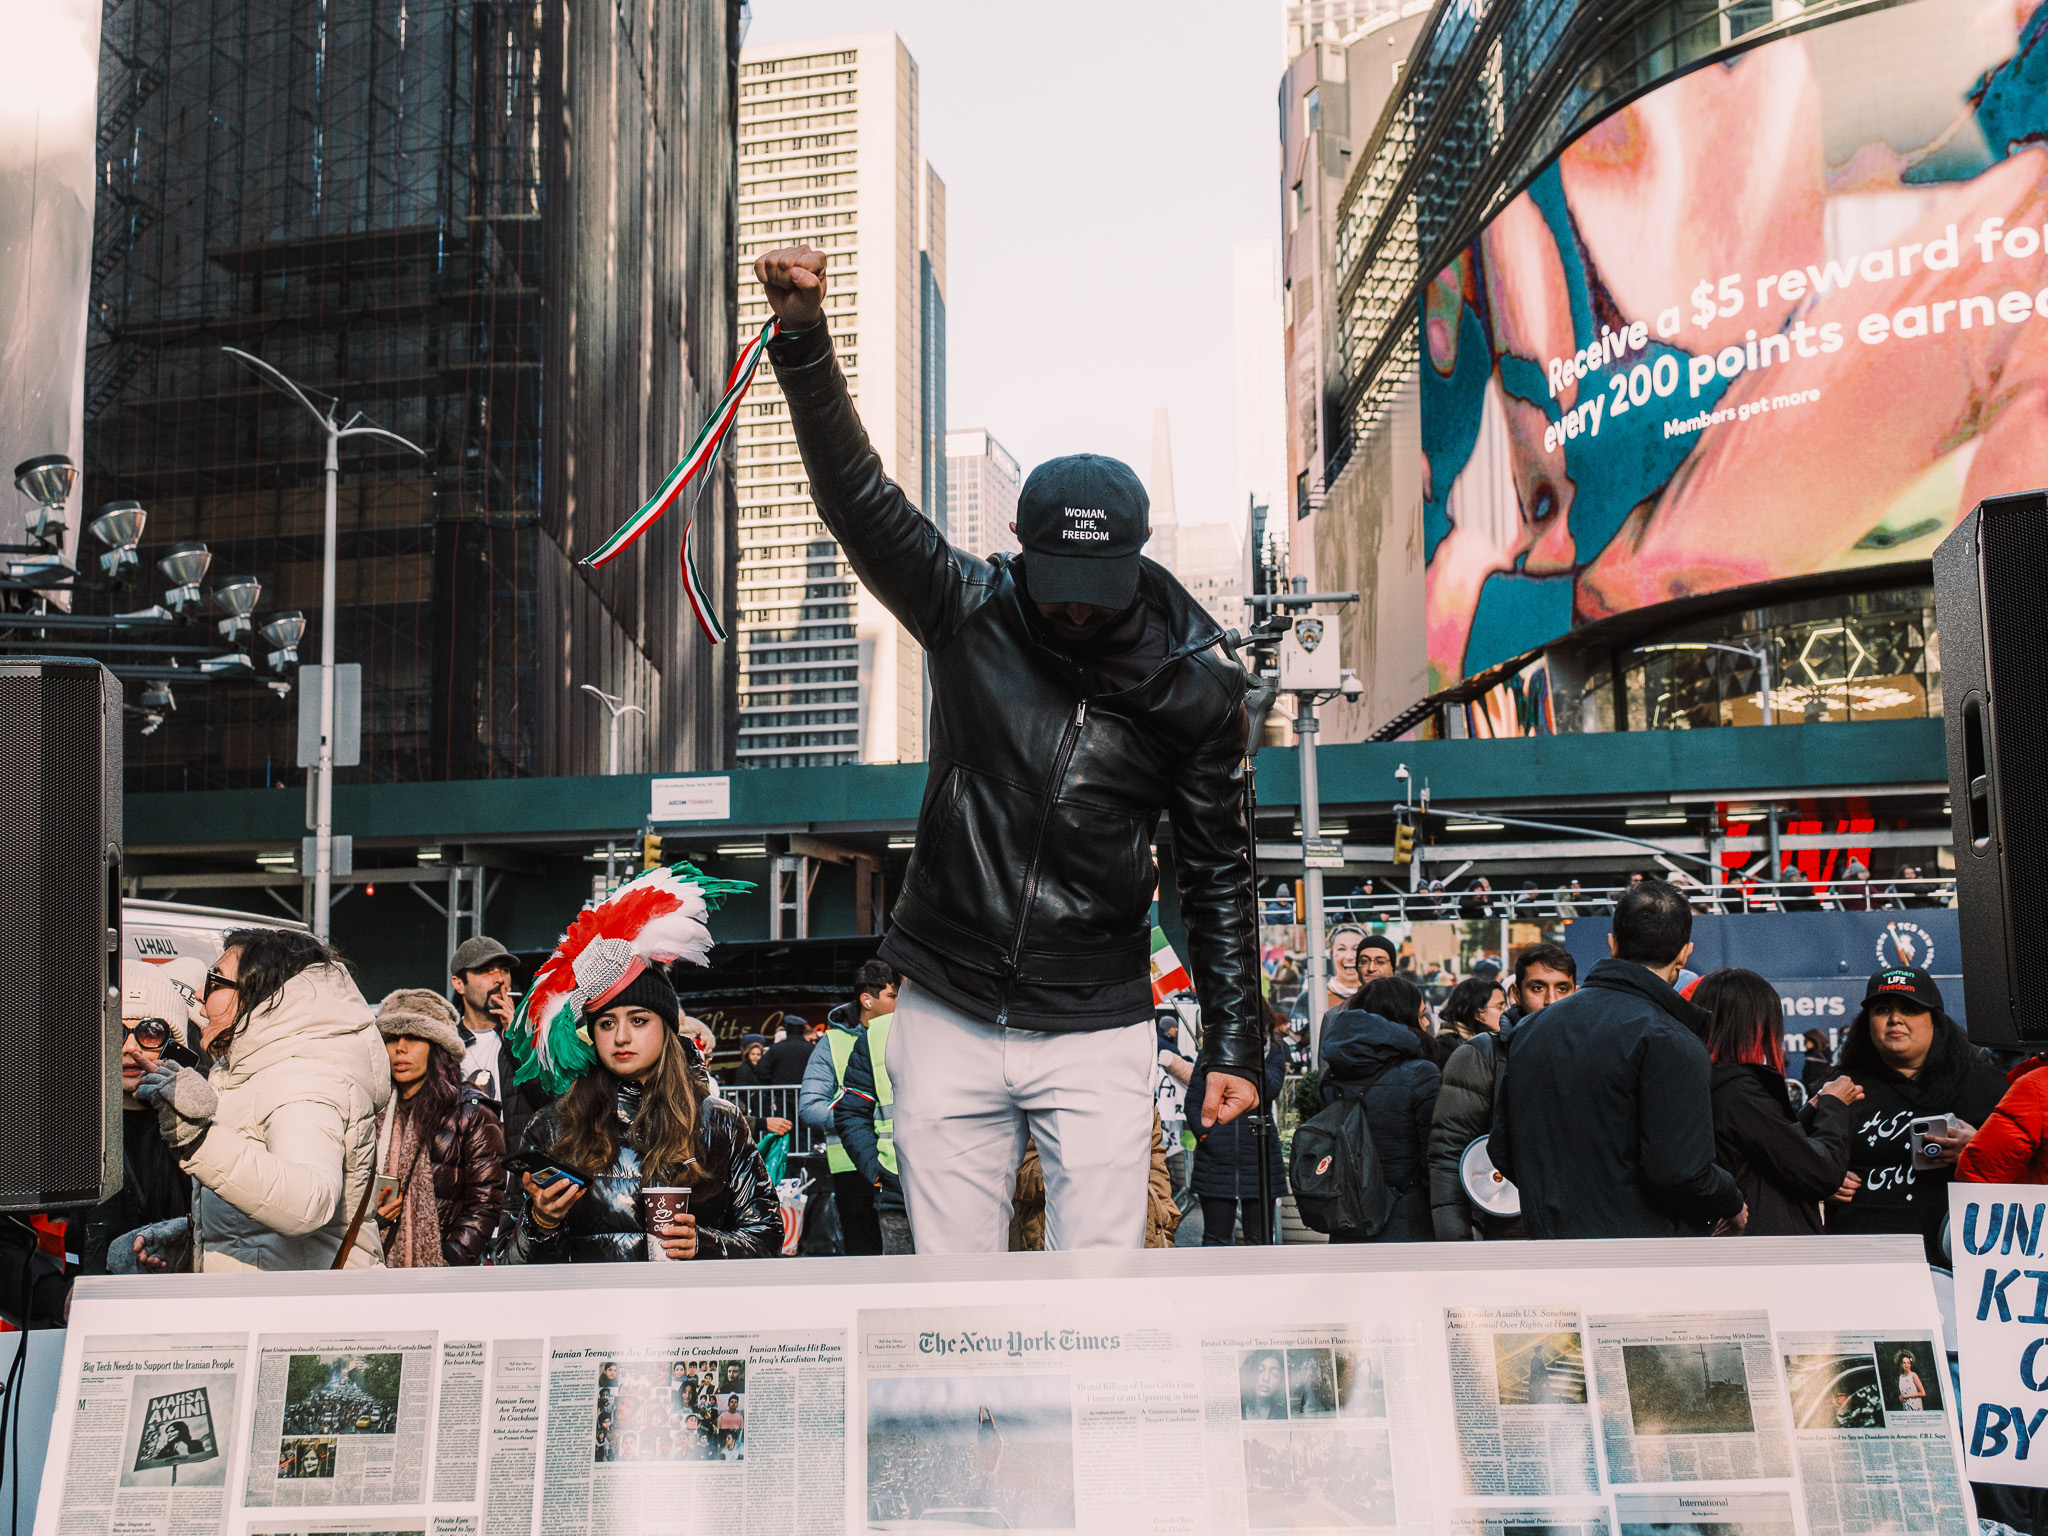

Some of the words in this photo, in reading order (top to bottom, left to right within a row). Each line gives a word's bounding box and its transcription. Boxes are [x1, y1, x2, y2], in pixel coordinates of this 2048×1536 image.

[1548, 319, 1649, 399] Receive
[1656, 305, 1681, 338] a
[1690, 273, 1745, 330] $5
[1756, 224, 1958, 308] reward
[1543, 394, 1606, 454] every
[1608, 353, 1679, 418] 200
[1688, 319, 1844, 399] points
[1663, 404, 1737, 440] Members
[1738, 396, 1768, 426] get
[1772, 387, 1821, 411] more
[1064, 506, 1107, 520] WOMAN,
[1075, 519, 1097, 531] LIFE,
[1062, 529, 1109, 541] FREEDOM
[134, 937, 179, 955] U-HAUL
[1882, 970, 1915, 978] woman
[1887, 975, 1907, 985] LIFE
[1878, 983, 1916, 993] Freedom
[1857, 1110, 1881, 1147] پلو
[1962, 1202, 2047, 1259] UN,
[1447, 1310, 1467, 1319] Iran's
[1468, 1310, 1494, 1318] Leader
[1496, 1309, 1522, 1318] Assails
[1523, 1309, 1539, 1318] U.S.
[1540, 1309, 1577, 1317] Sanctions
[1447, 1321, 1468, 1329] Amid
[1470, 1321, 1498, 1329] Turmoil
[1500, 1321, 1518, 1329] Over
[1519, 1320, 1543, 1330] Rights
[1544, 1320, 1553, 1328] at
[1554, 1320, 1577, 1328] Home
[749, 1345, 776, 1353] Iranian
[777, 1344, 806, 1352] Missiles
[807, 1343, 819, 1352] Hit
[820, 1343, 841, 1351] Bases
[919, 1331, 957, 1357] The
[959, 1331, 1002, 1355] New
[1006, 1329, 1056, 1357] York
[1059, 1328, 1121, 1351] Times
[1222, 1339, 1245, 1348] Killing
[1246, 1338, 1252, 1346] of
[1254, 1338, 1268, 1346] Two
[1270, 1338, 1296, 1348] Teenage
[1297, 1337, 1313, 1345] Girls
[1314, 1337, 1330, 1345] Fans
[1331, 1336, 1355, 1345] Flames
[551, 1349, 582, 1360] Iranian
[584, 1348, 625, 1360] Teenagers
[626, 1348, 643, 1357] Are
[644, 1346, 680, 1359] Targeted
[681, 1347, 690, 1356] in
[691, 1345, 739, 1356] Crackdown
[83, 1361, 94, 1372] Big
[96, 1360, 112, 1371] Tech
[113, 1360, 134, 1371] Needs
[135, 1361, 142, 1370] to
[143, 1359, 172, 1372] Support
[172, 1359, 183, 1370] the
[185, 1359, 211, 1370] Iranian
[211, 1358, 235, 1371] People
[748, 1356, 757, 1364] In
[758, 1355, 779, 1366] Iraq's
[780, 1355, 816, 1364] Kurdistan
[817, 1354, 843, 1364] Region
[1156, 1380, 1175, 1389] Girls
[1176, 1380, 1195, 1389] Fans
[151, 1390, 205, 1411] MAHSA
[1138, 1393, 1171, 1403] Uprising
[1173, 1392, 1181, 1400] in
[1182, 1392, 1199, 1400] Iran
[147, 1400, 207, 1424] AMINI
[1679, 1498, 1729, 1507] International
[455, 1516, 469, 1524] Eyes
[464, 1525, 476, 1533] Spy
